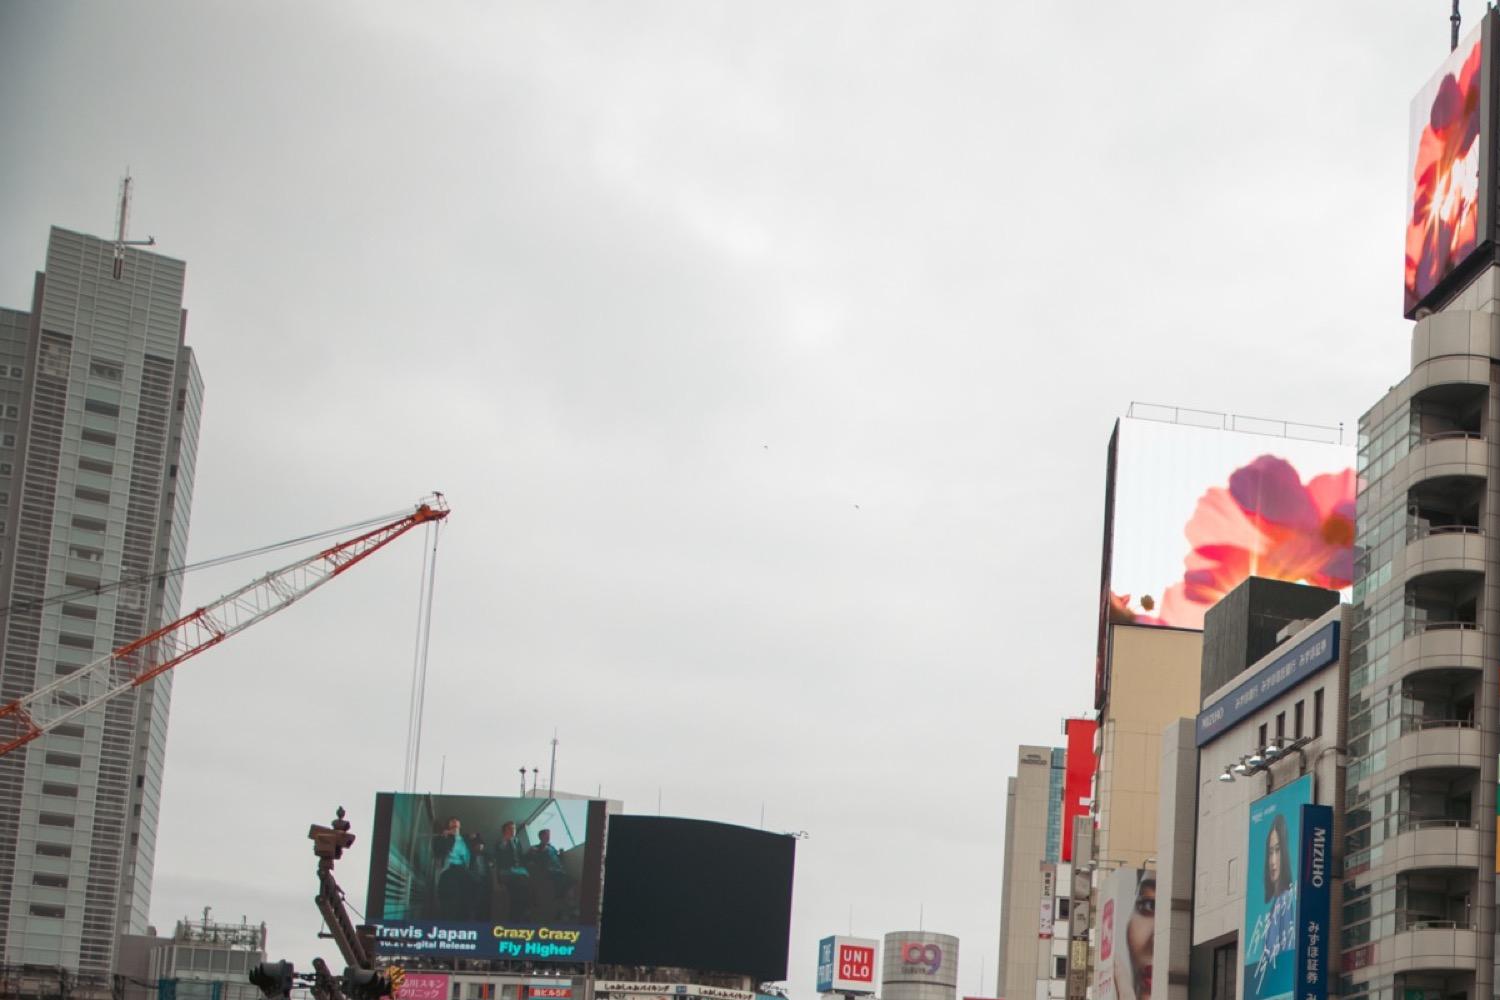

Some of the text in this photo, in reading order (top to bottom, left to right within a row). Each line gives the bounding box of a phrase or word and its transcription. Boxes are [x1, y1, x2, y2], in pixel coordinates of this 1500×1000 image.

[1312, 828, 1326, 888] MIZUHO
[375, 924, 478, 941] Travis Japan
[493, 926, 580, 942] Crazy Crazy
[439, 941, 476, 950] Release
[499, 942, 575, 957] Fly Higher
[1306, 922, 1320, 984] みずほ証券
[843, 950, 868, 962] UNI
[901, 942, 942, 975] 109
[842, 964, 870, 979] QLO
